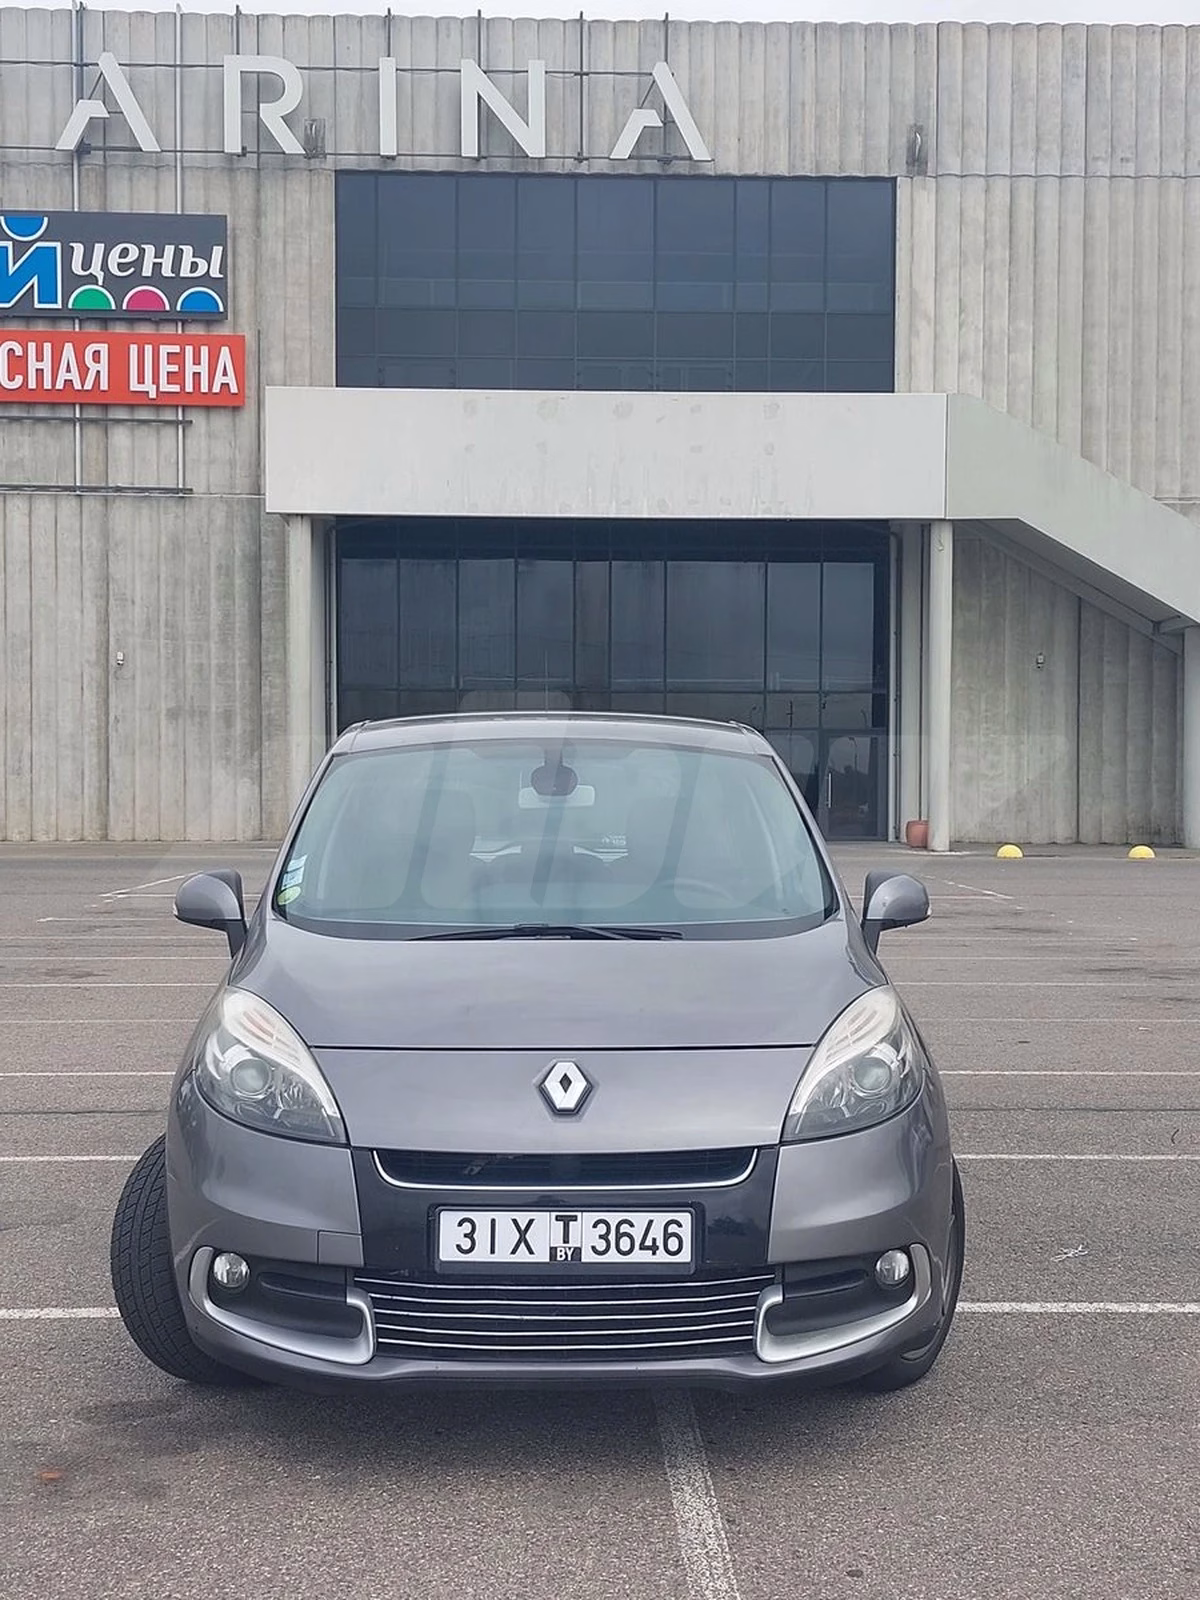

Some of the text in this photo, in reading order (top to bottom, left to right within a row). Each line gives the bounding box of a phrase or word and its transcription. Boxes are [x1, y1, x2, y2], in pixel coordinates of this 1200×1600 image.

[54, 51, 712, 162] ARINA
[69, 241, 224, 286] цены
[128, 343, 239, 399] ЦЕНА
[556, 1248, 575, 1262] BY
[590, 1218, 684, 1256] 3646
